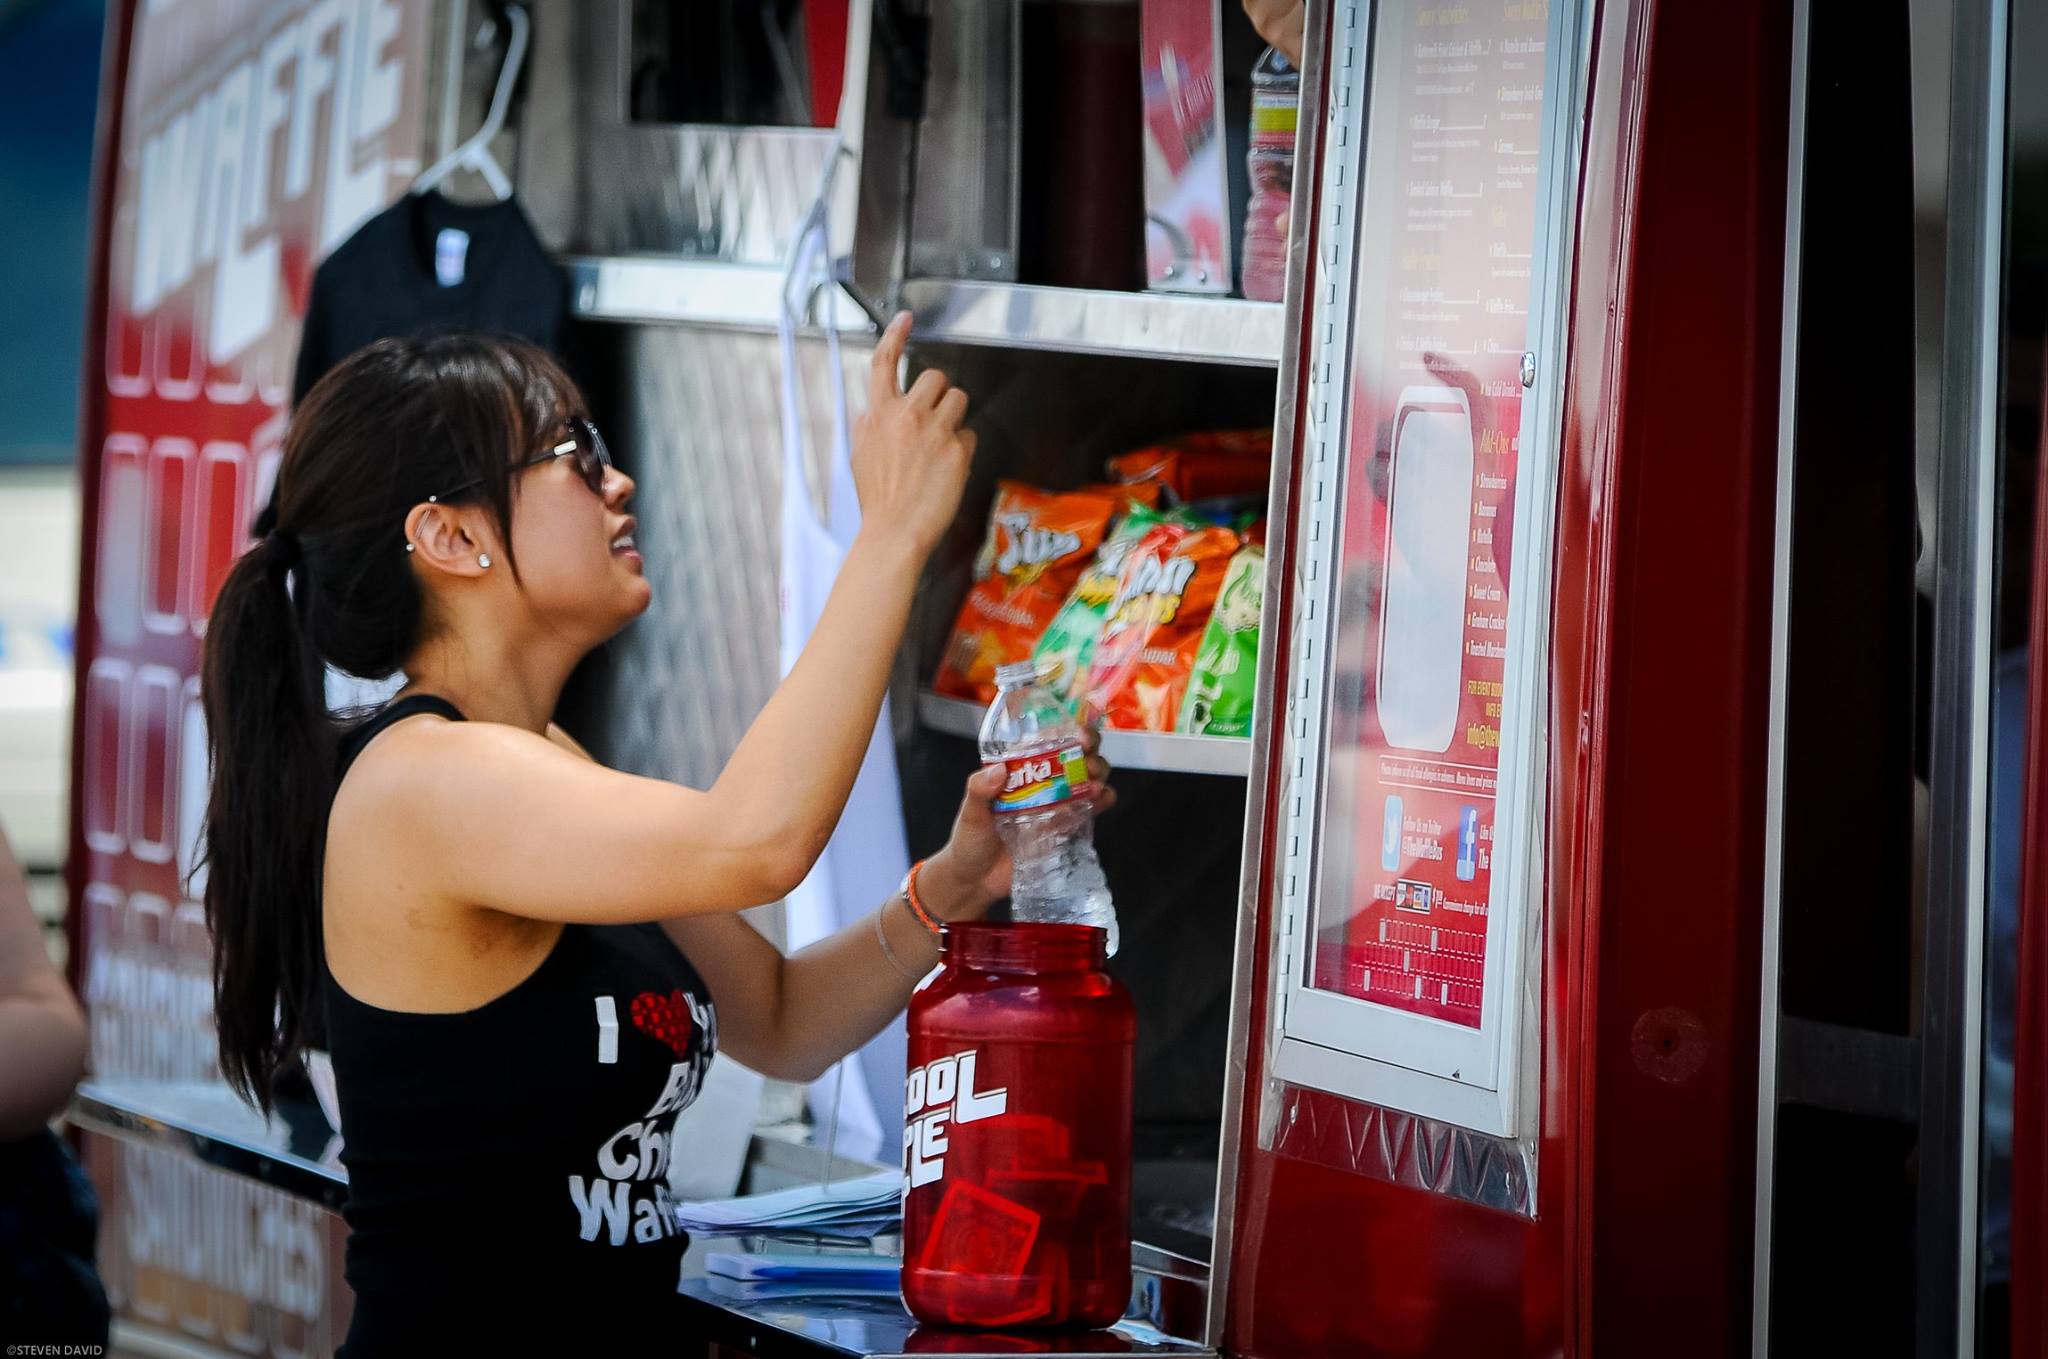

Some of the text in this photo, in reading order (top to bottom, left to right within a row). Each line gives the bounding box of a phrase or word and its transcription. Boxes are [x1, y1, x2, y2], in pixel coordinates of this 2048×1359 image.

[1004, 759, 1052, 792] arka
[594, 994, 619, 1064] I
[904, 1050, 1008, 1124] OOL
